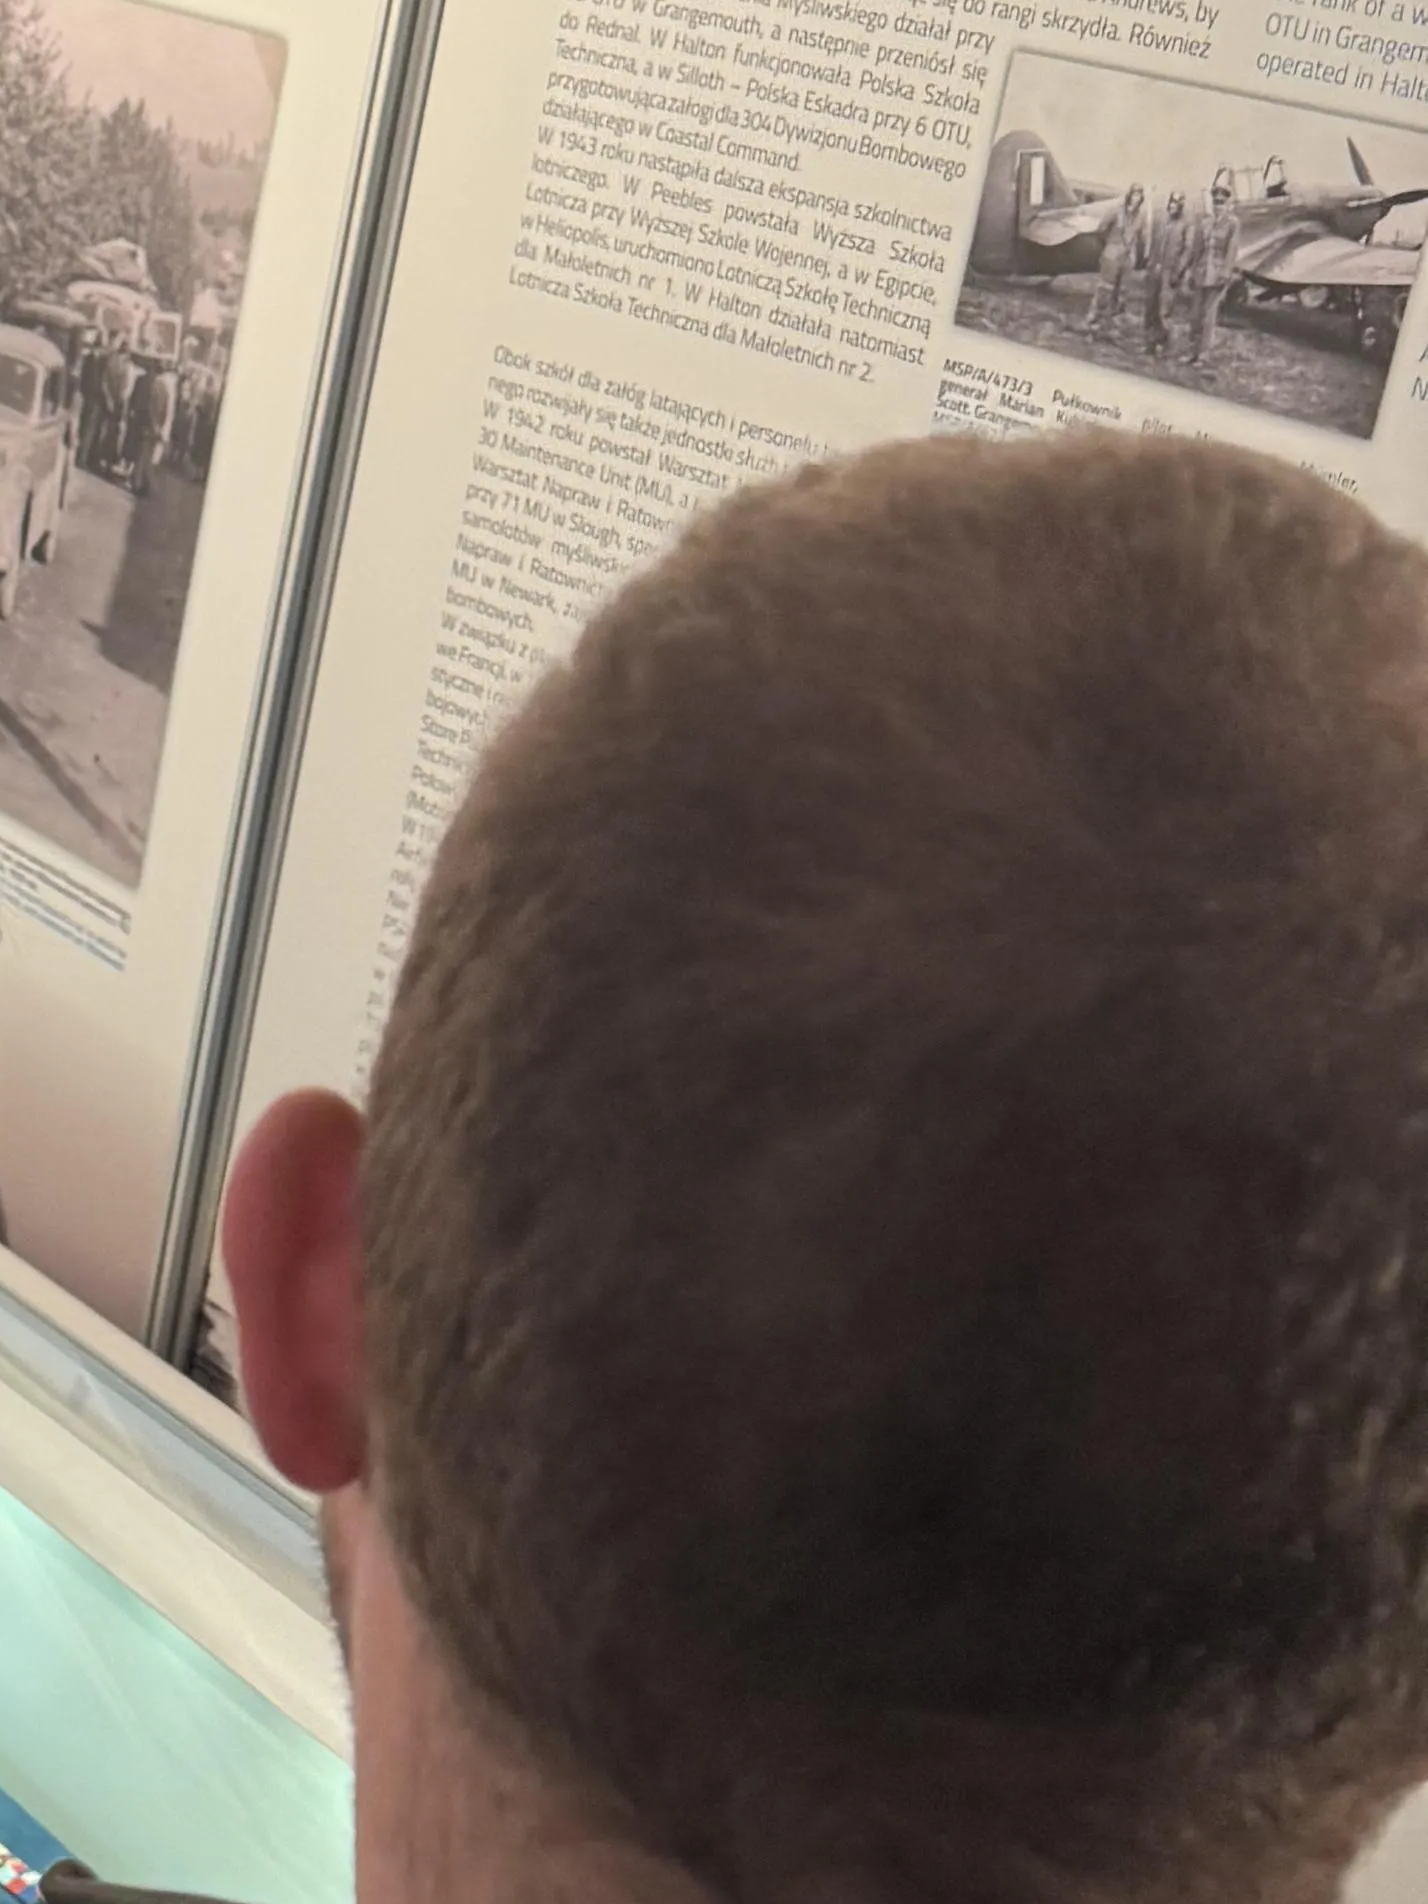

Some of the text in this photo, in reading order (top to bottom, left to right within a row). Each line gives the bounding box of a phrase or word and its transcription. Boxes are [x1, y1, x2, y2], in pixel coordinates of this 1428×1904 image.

[1265, 11, 1311, 41] OTU
[1390, 3, 1405, 22] a
[1256, 52, 1350, 86] operated
